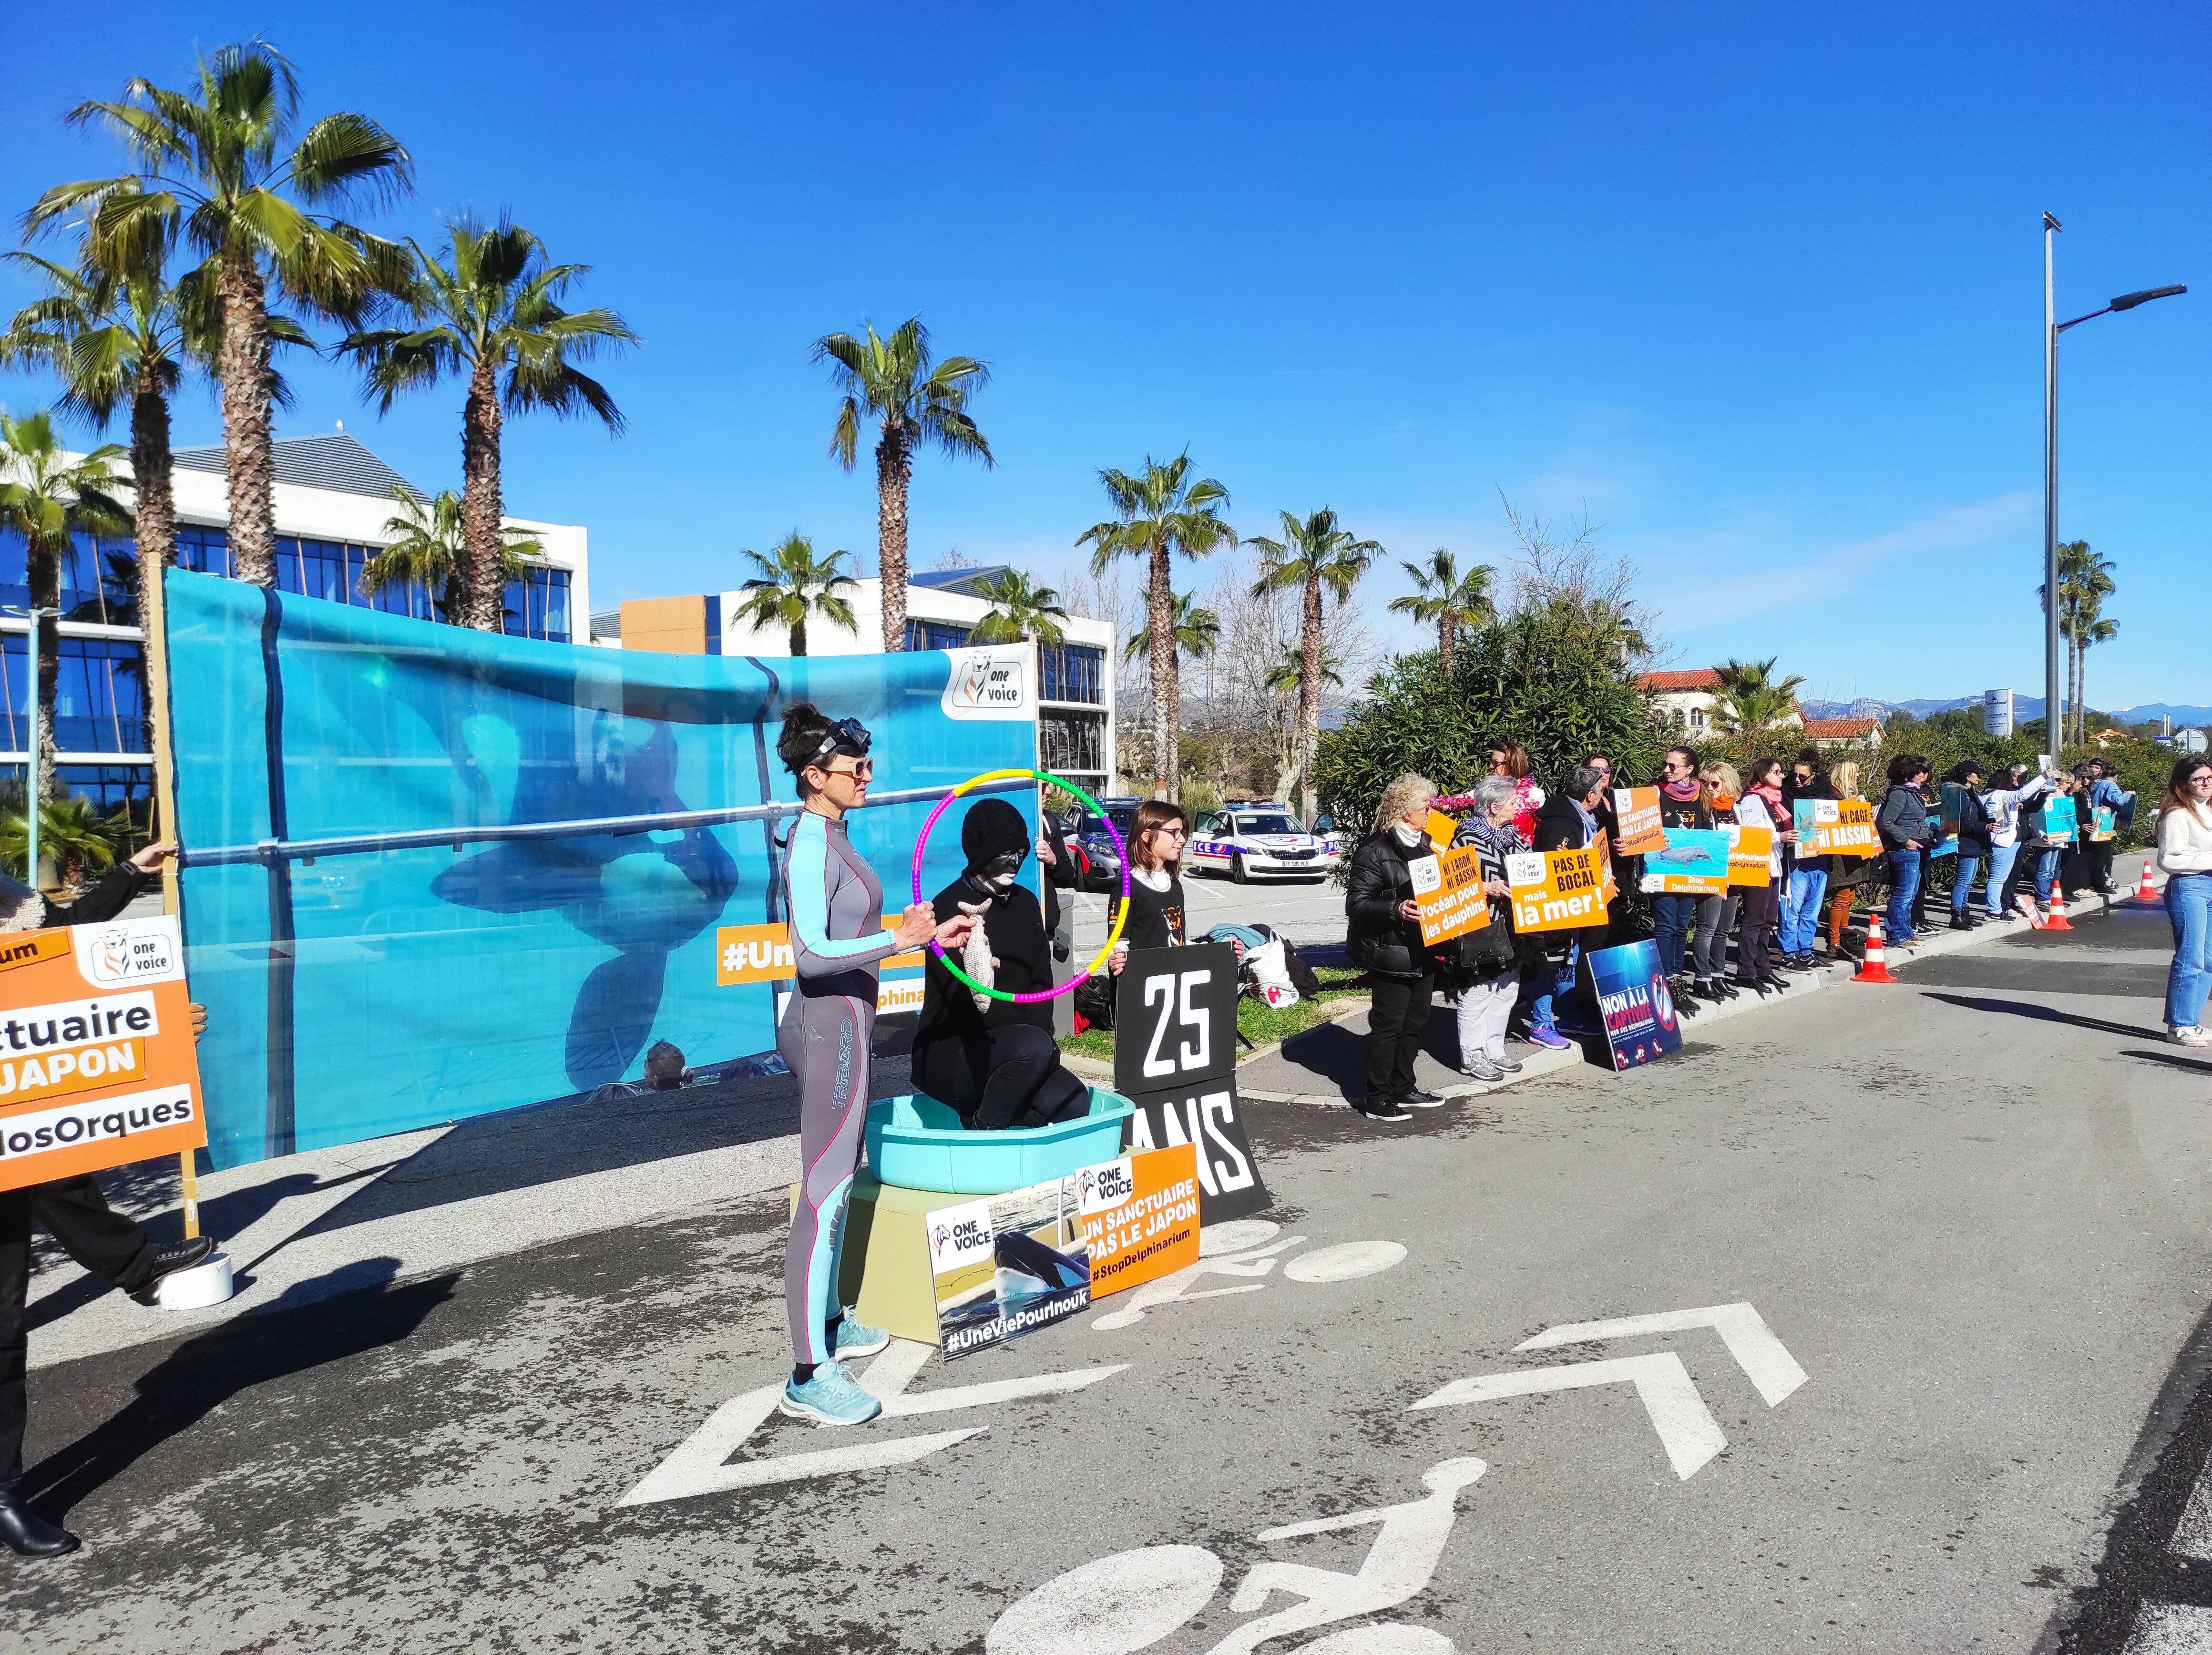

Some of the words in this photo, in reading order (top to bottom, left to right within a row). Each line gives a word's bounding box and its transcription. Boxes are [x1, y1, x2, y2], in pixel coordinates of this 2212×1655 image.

[991, 670, 1009, 682] one
[988, 684, 1017, 701] voice
[1619, 816, 1628, 826] UN
[1628, 805, 1659, 823] SANCTUAIRE
[1621, 825, 1634, 838] PAS
[1634, 822, 1642, 833] LE
[1643, 815, 1661, 830] JAPON
[1840, 811, 1848, 824] NI
[1193, 841, 1211, 852] ICE
[1818, 828, 1831, 848] NI
[1832, 825, 1872, 846] BASSIN
[1443, 862, 1451, 876] NI
[1452, 853, 1473, 872] LAGON,
[1553, 856, 1574, 874] PAS
[1577, 853, 1590, 869] DE
[1446, 878, 1454, 890] NI
[1454, 866, 1477, 887] BASSIN
[1557, 870, 1596, 892] BOCAL
[1672, 883, 1720, 892] Delphinarium
[1419, 894, 1457, 921] l'océan
[1456, 882, 1479, 906] pour
[1524, 889, 1547, 902] mais
[1423, 922, 1441, 940] les
[1442, 899, 1486, 930] dauphins
[1515, 902, 1540, 927] la
[1543, 893, 1592, 922] mer
[133, 942, 155, 955] one
[723, 940, 794, 971] #Un
[136, 955, 167, 971] voice
[1602, 993, 1628, 1016] NON
[1636, 987, 1649, 1005] LA
[0, 1003, 151, 1051] tuaire
[1143, 970, 1211, 1078] 25
[0, 1042, 136, 1094] JAPON
[1098, 1168, 1121, 1184] ONE
[1099, 1178, 1132, 1200] VOICE
[1083, 1217, 1103, 1241] UN
[1106, 1178, 1195, 1231] SANCTUAIRE
[953, 1220, 978, 1237] ONE
[1087, 1232, 1118, 1261] PAS
[1121, 1222, 1143, 1248] LE
[1146, 1196, 1197, 1238] JAPON
[955, 1231, 991, 1251] VOICE
[1093, 1229, 1190, 1283] #StopDelphinarium
[947, 1291, 1087, 1352] #UneViePourInouk
